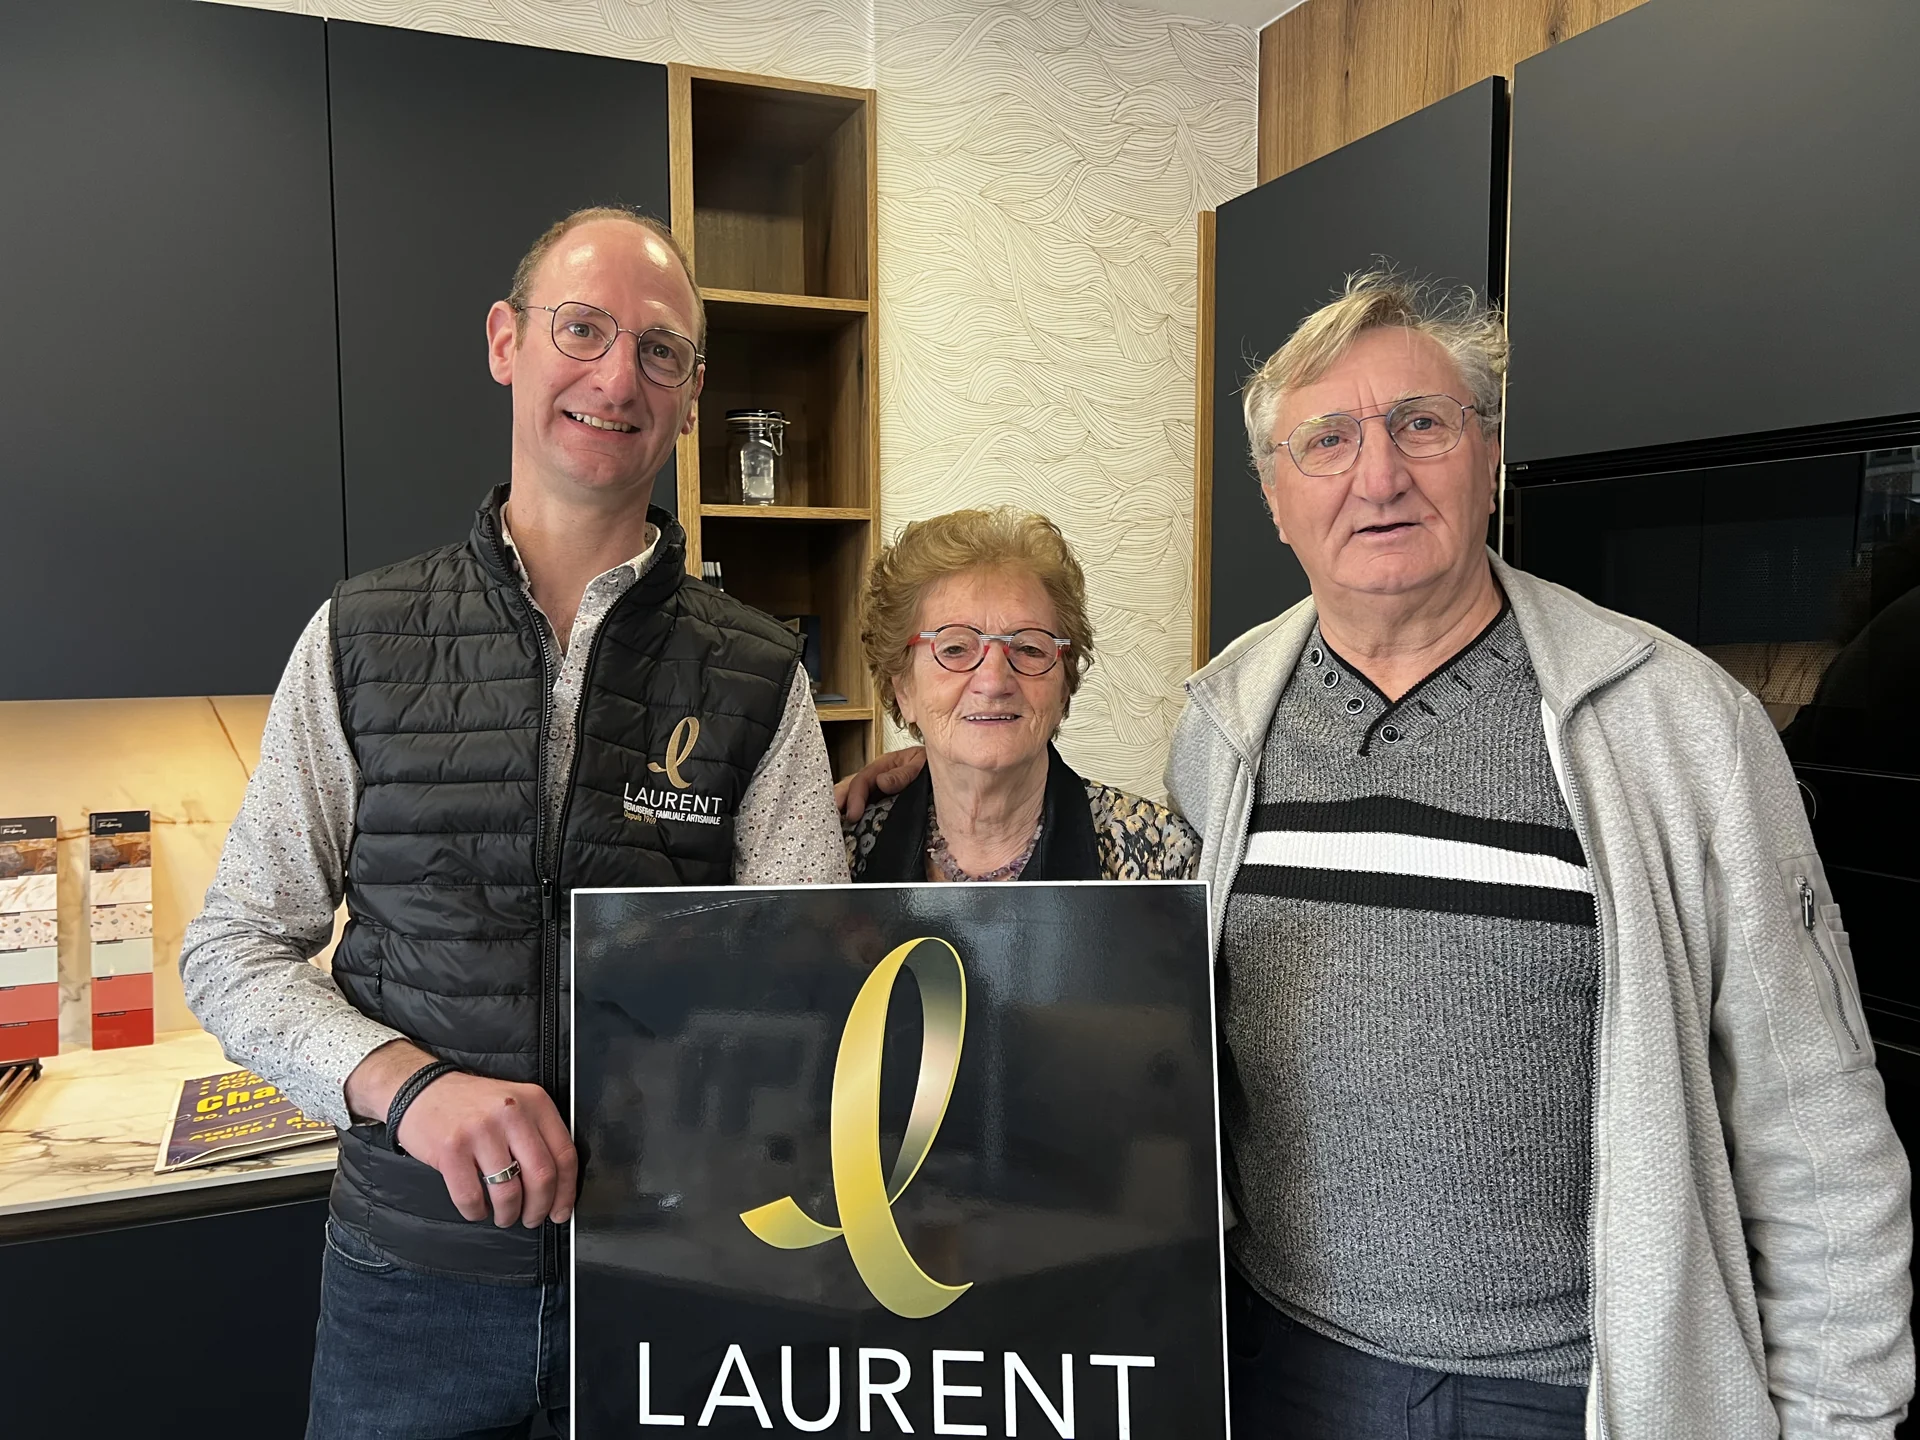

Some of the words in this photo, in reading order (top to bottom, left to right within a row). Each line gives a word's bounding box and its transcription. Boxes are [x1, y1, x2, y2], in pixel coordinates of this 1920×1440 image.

[623, 782, 723, 815] LAURENT
[655, 810, 686, 822] FAMILIALE
[686, 813, 721, 826] ARTISANALE
[197, 1086, 283, 1113] Cha
[638, 1341, 1156, 1440] LAURENT
